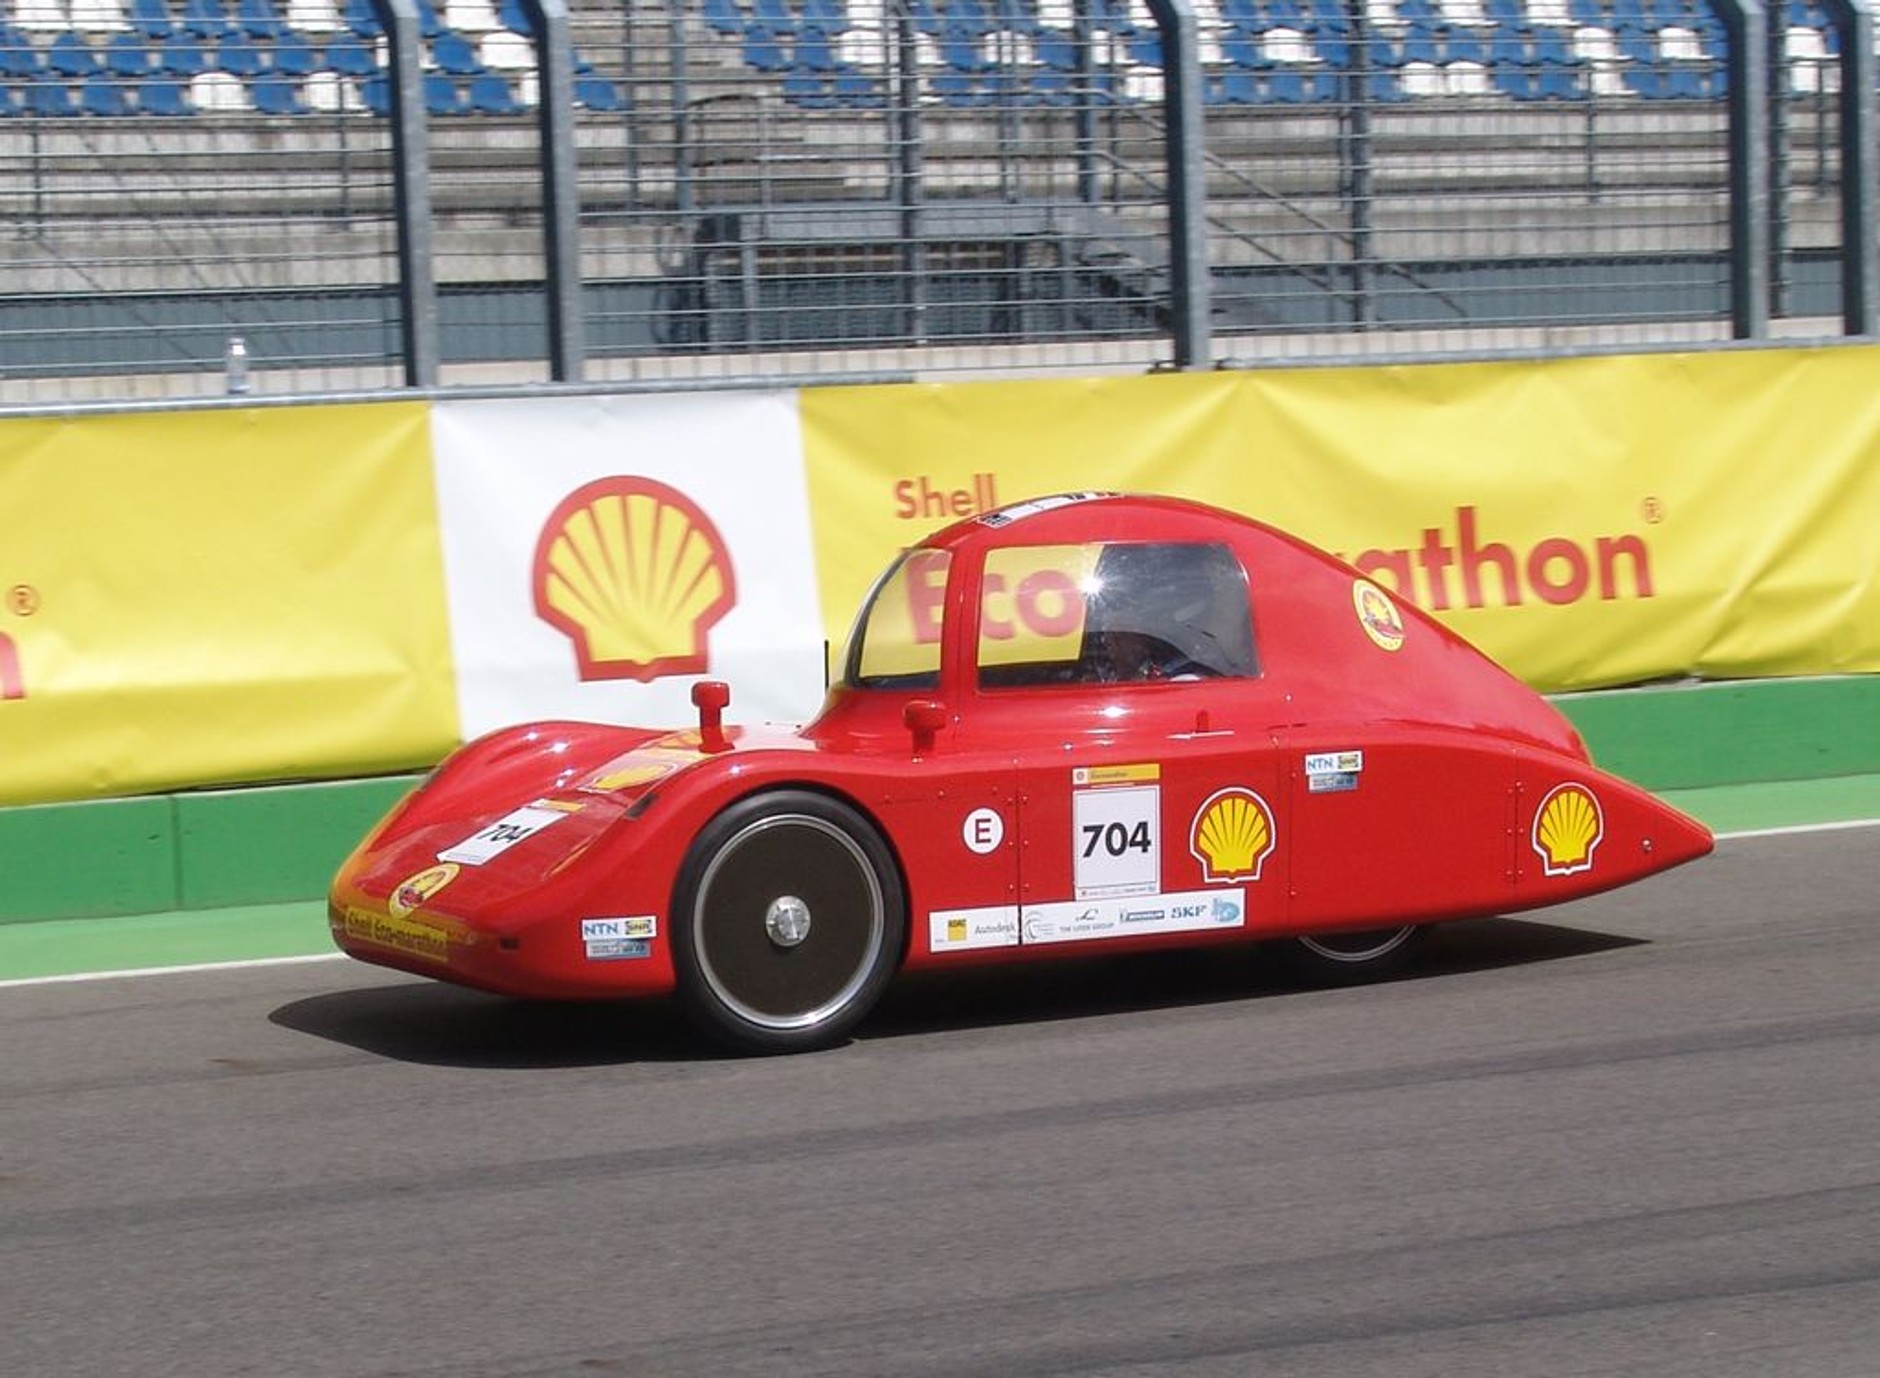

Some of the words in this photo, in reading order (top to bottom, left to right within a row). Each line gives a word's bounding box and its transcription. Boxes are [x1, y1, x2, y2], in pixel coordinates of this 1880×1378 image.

[894, 473, 997, 520] Shell
[476, 824, 534, 844] 704
[974, 818, 992, 844] E
[1082, 820, 1151, 858] 704
[1170, 904, 1207, 919] SKF
[584, 922, 618, 936] NTN
[974, 920, 1016, 935] Autodesk
